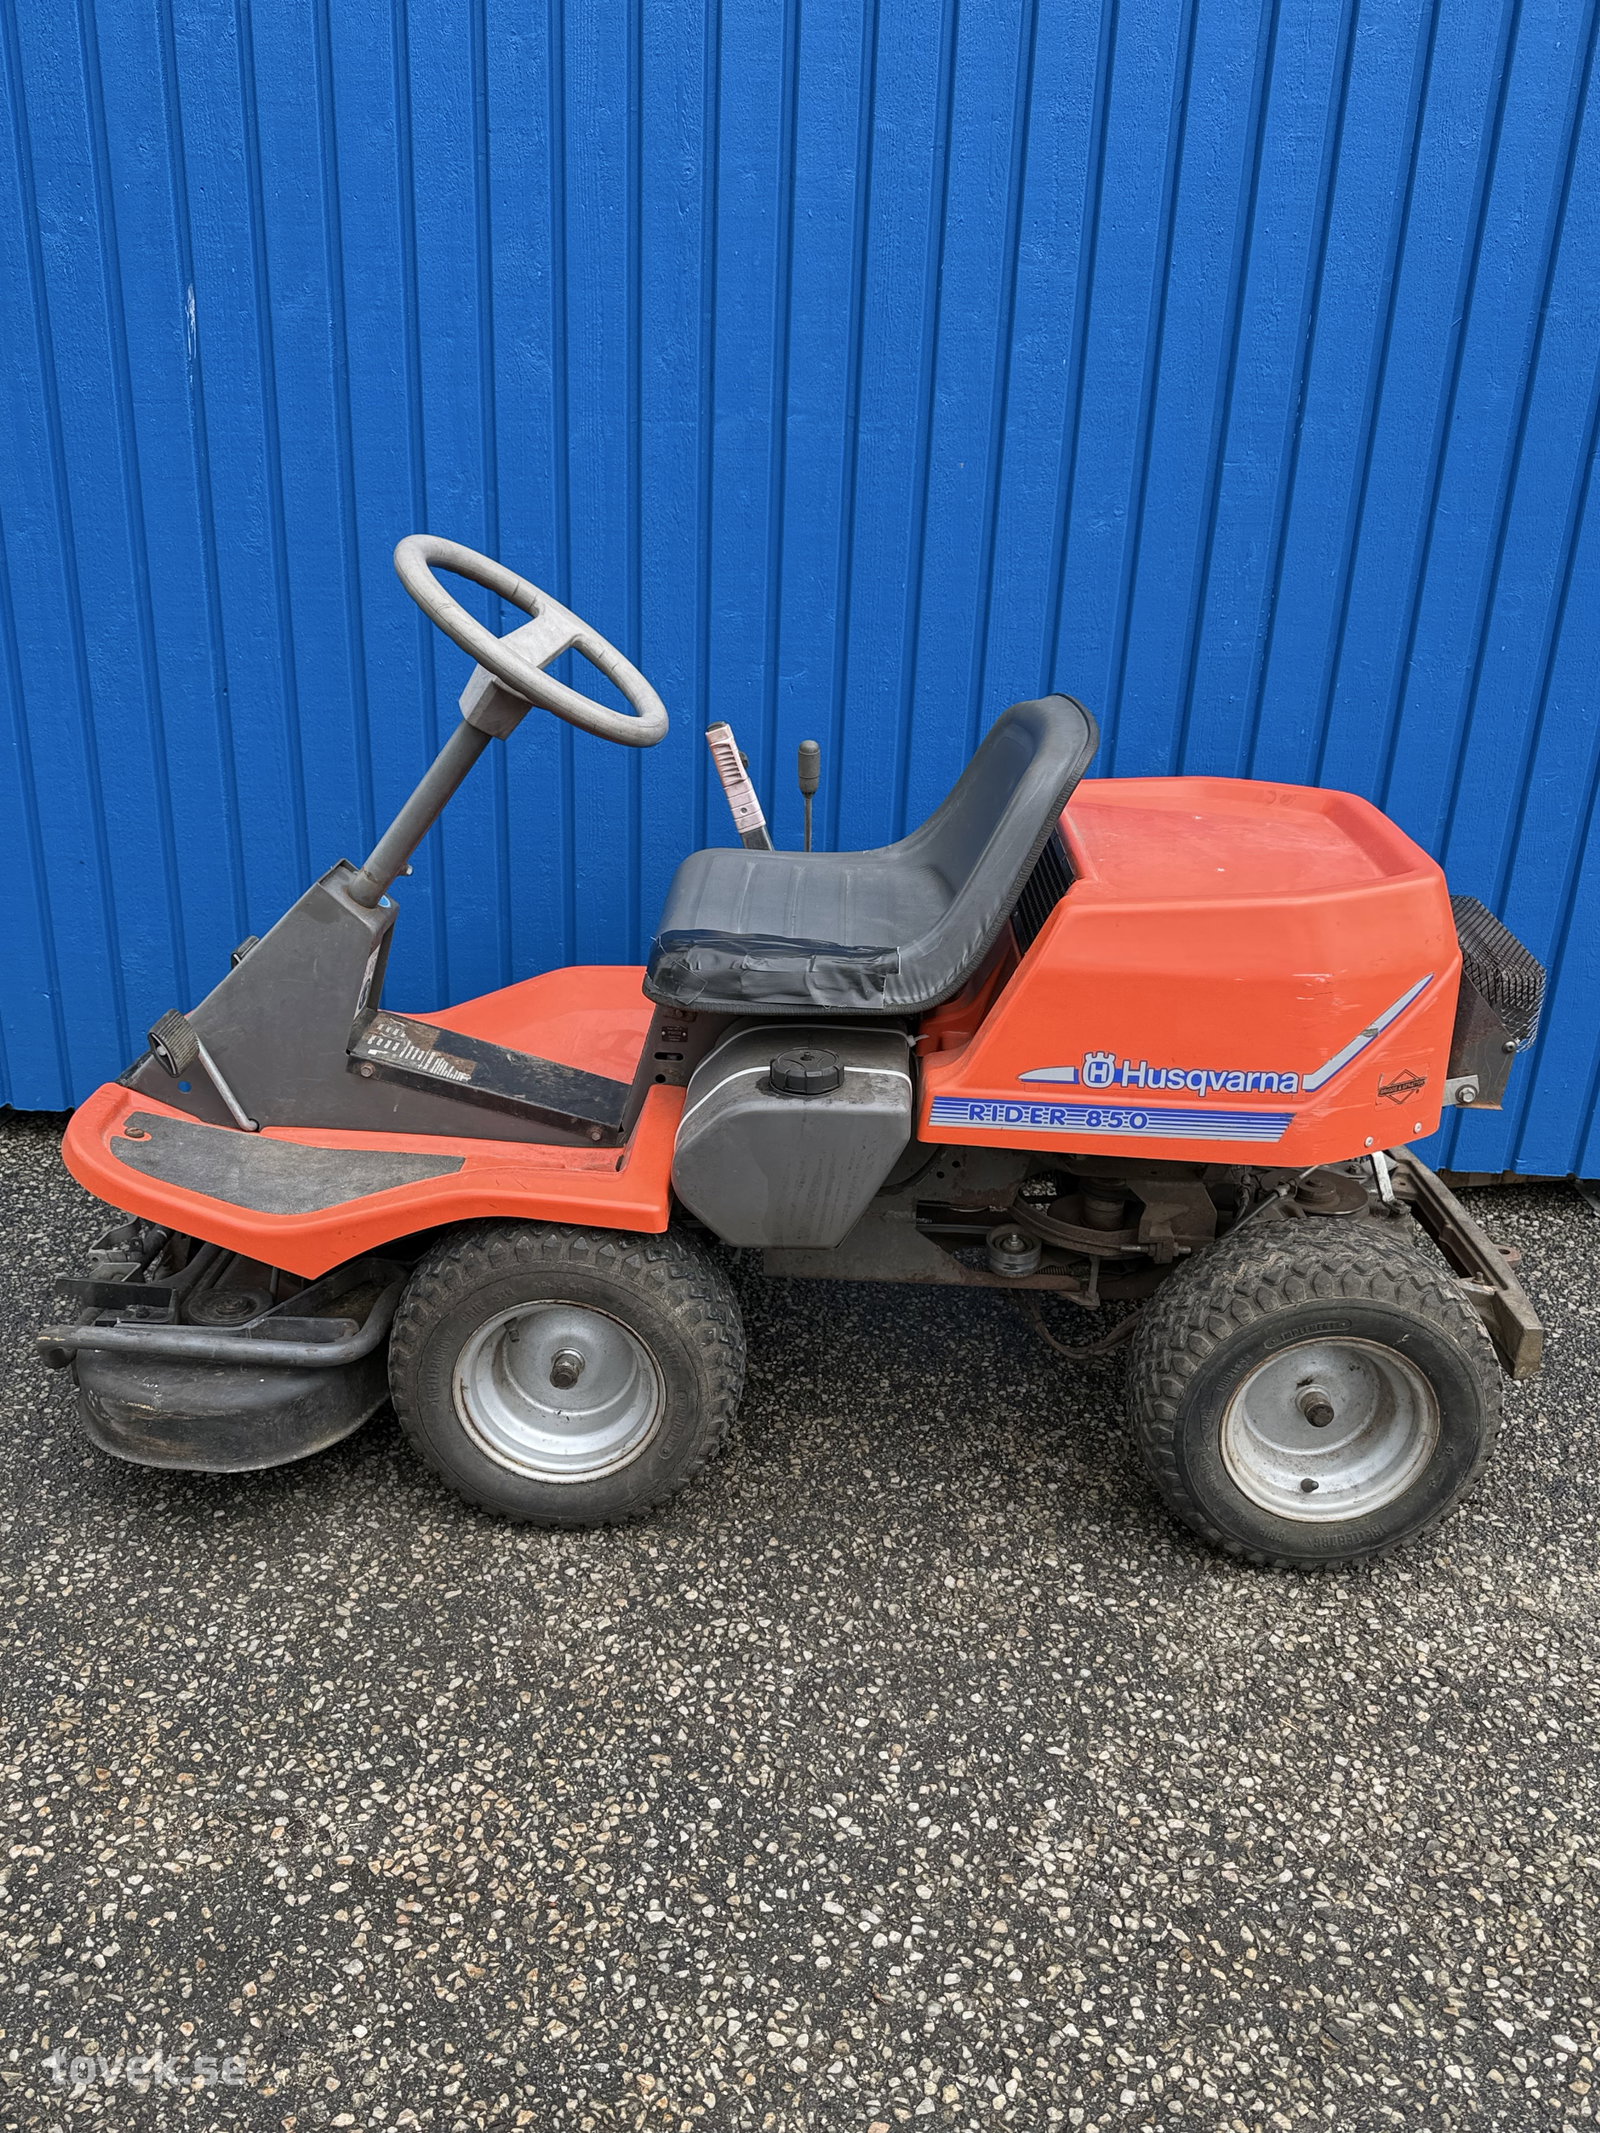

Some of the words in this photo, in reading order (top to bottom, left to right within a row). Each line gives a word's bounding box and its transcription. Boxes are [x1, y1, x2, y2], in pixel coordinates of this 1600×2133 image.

[1120, 1059, 1299, 1097] Husqvarna
[968, 1104, 1067, 1126] RIDER
[1085, 1110, 1148, 1130] 850
